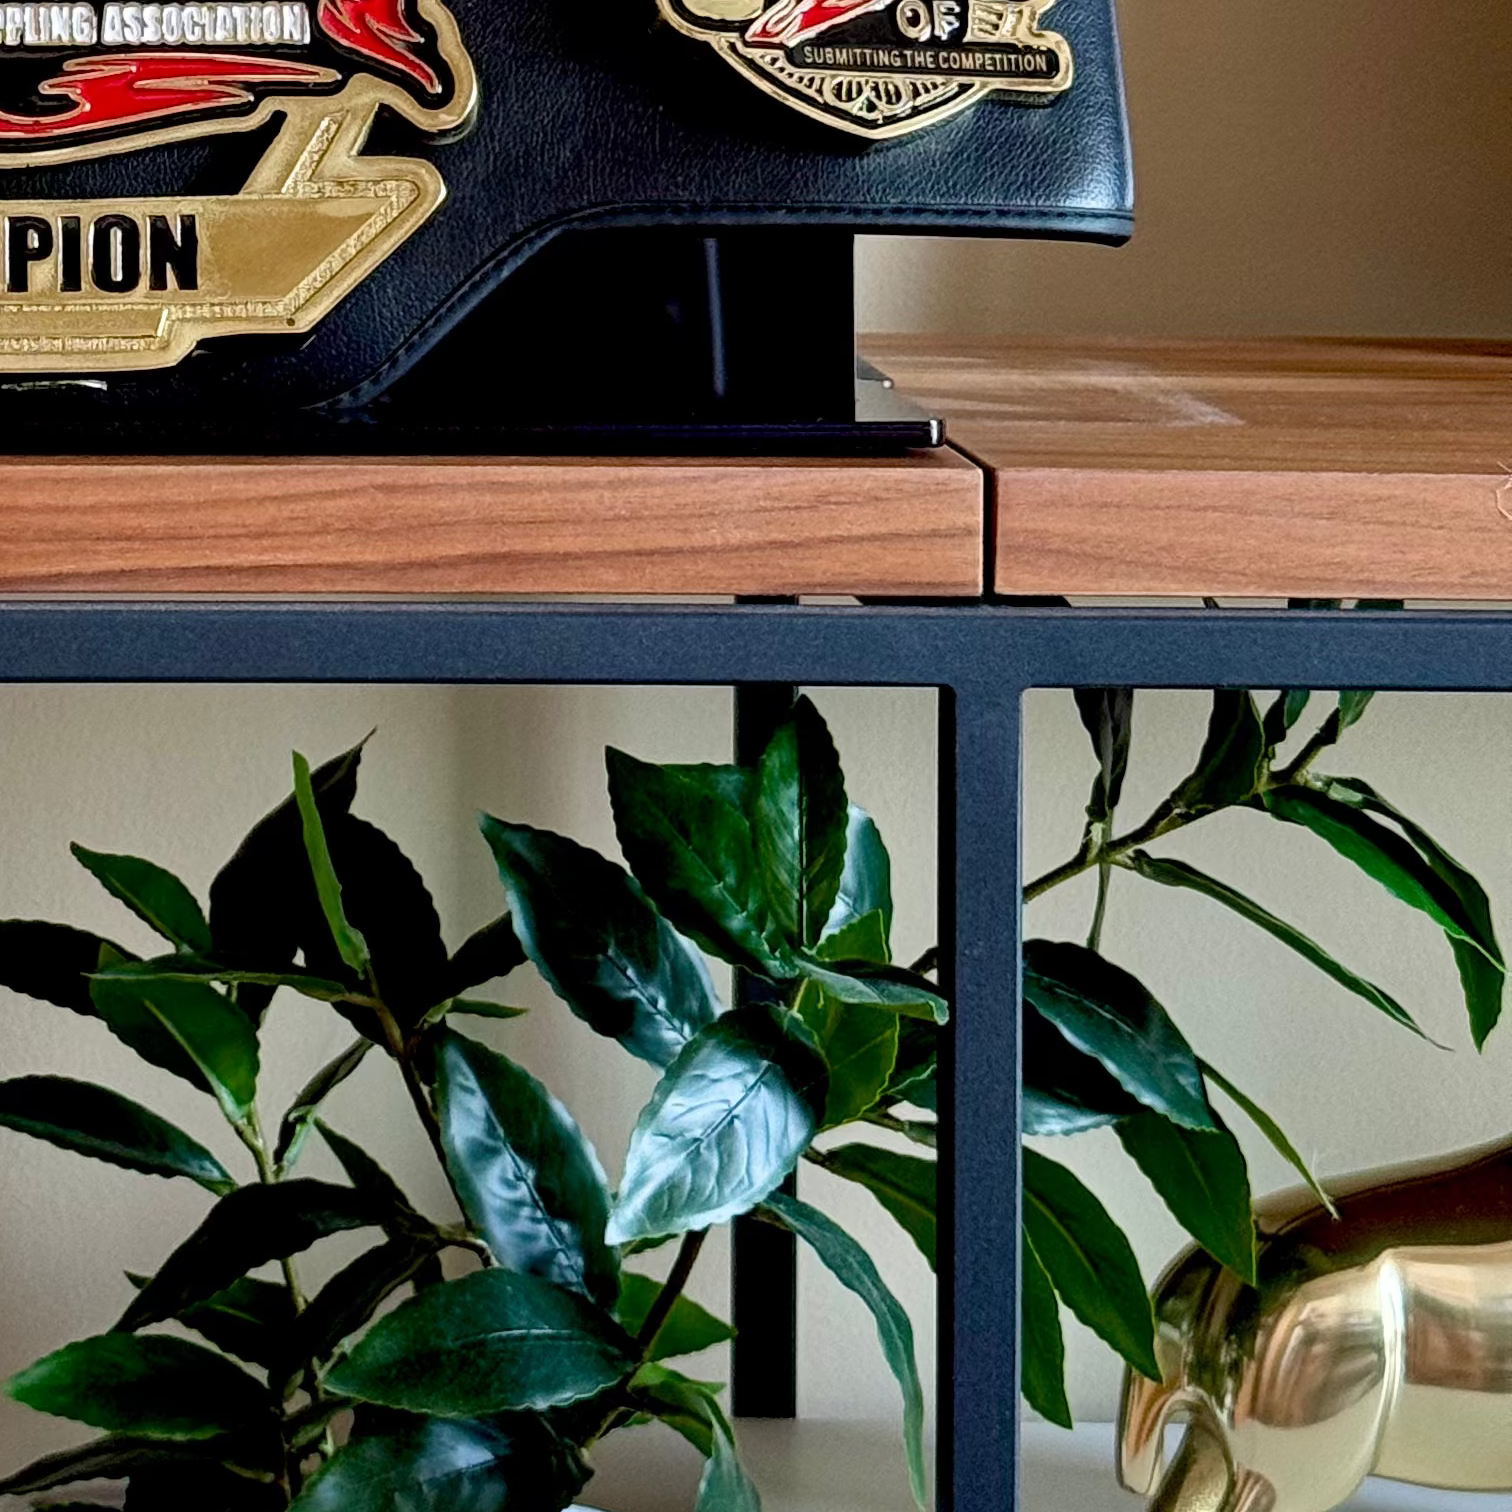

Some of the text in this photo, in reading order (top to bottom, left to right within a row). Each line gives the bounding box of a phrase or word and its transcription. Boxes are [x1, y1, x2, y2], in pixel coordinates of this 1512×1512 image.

[101, 2, 310, 46] ASSOCIATION
[804, 46, 1048, 72] SUBMITTING THE COMPETITION
